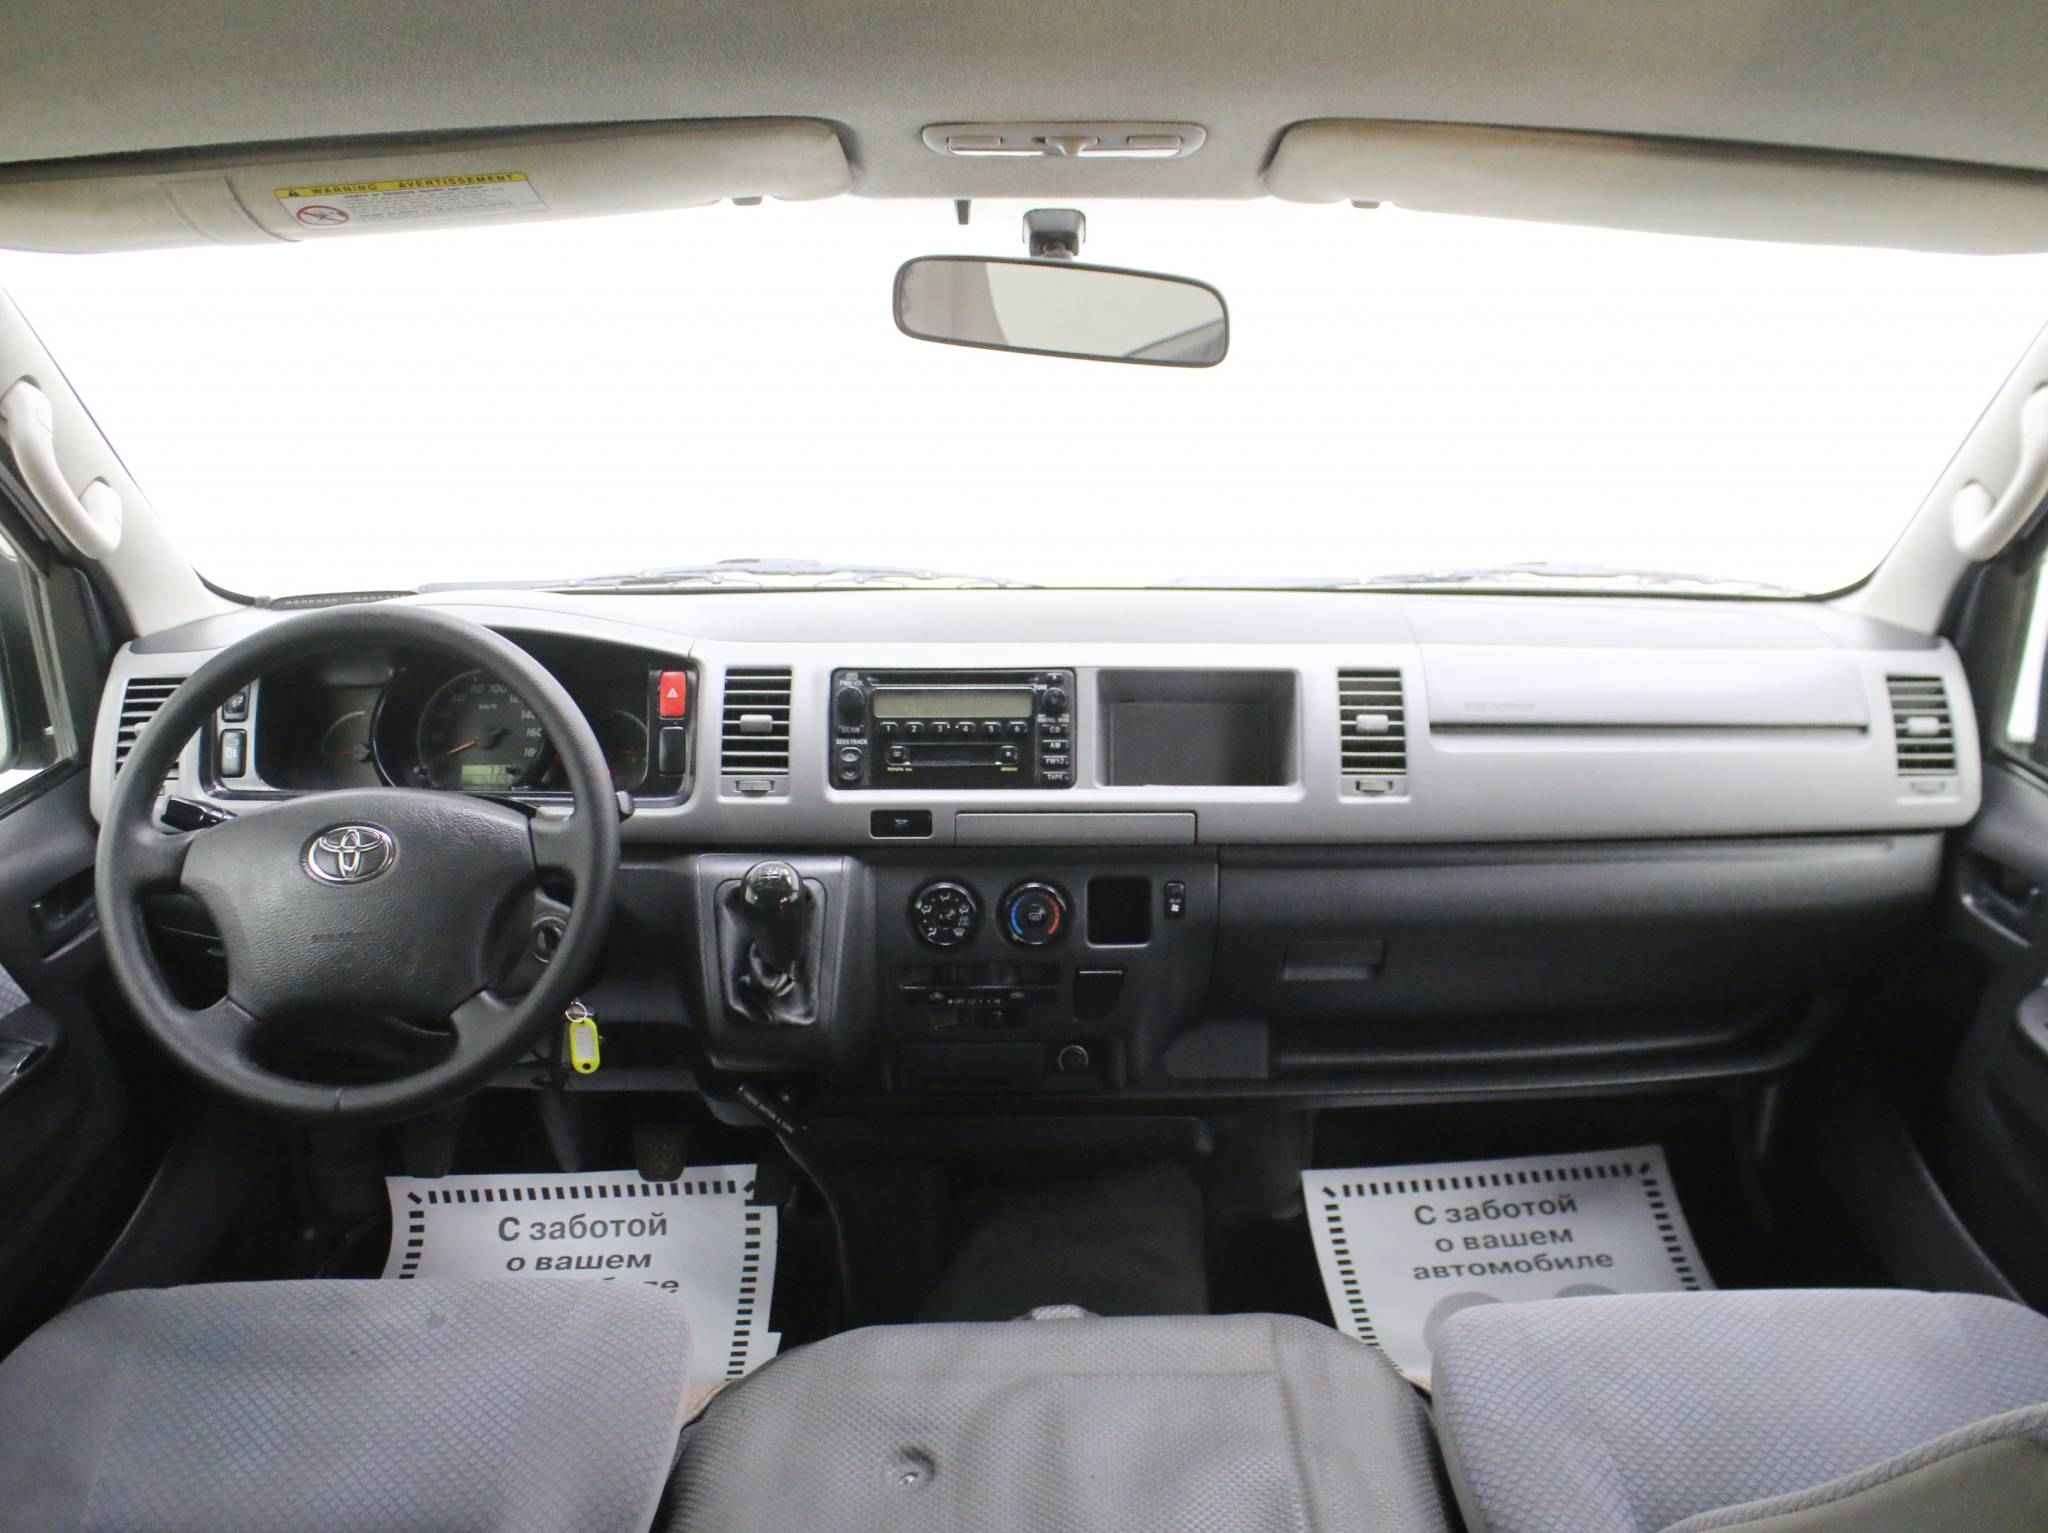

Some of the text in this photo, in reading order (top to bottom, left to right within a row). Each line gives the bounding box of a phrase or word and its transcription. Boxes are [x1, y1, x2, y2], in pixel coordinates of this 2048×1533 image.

[311, 174, 513, 194] WARNING AVERTISSEMENT
[1414, 1193, 1578, 1226] С заботой
[498, 1211, 668, 1242] С заботой
[1435, 1228, 1574, 1253] о вашем
[505, 1251, 652, 1272] о вашем
[1412, 1252, 1615, 1281] автомобиле
